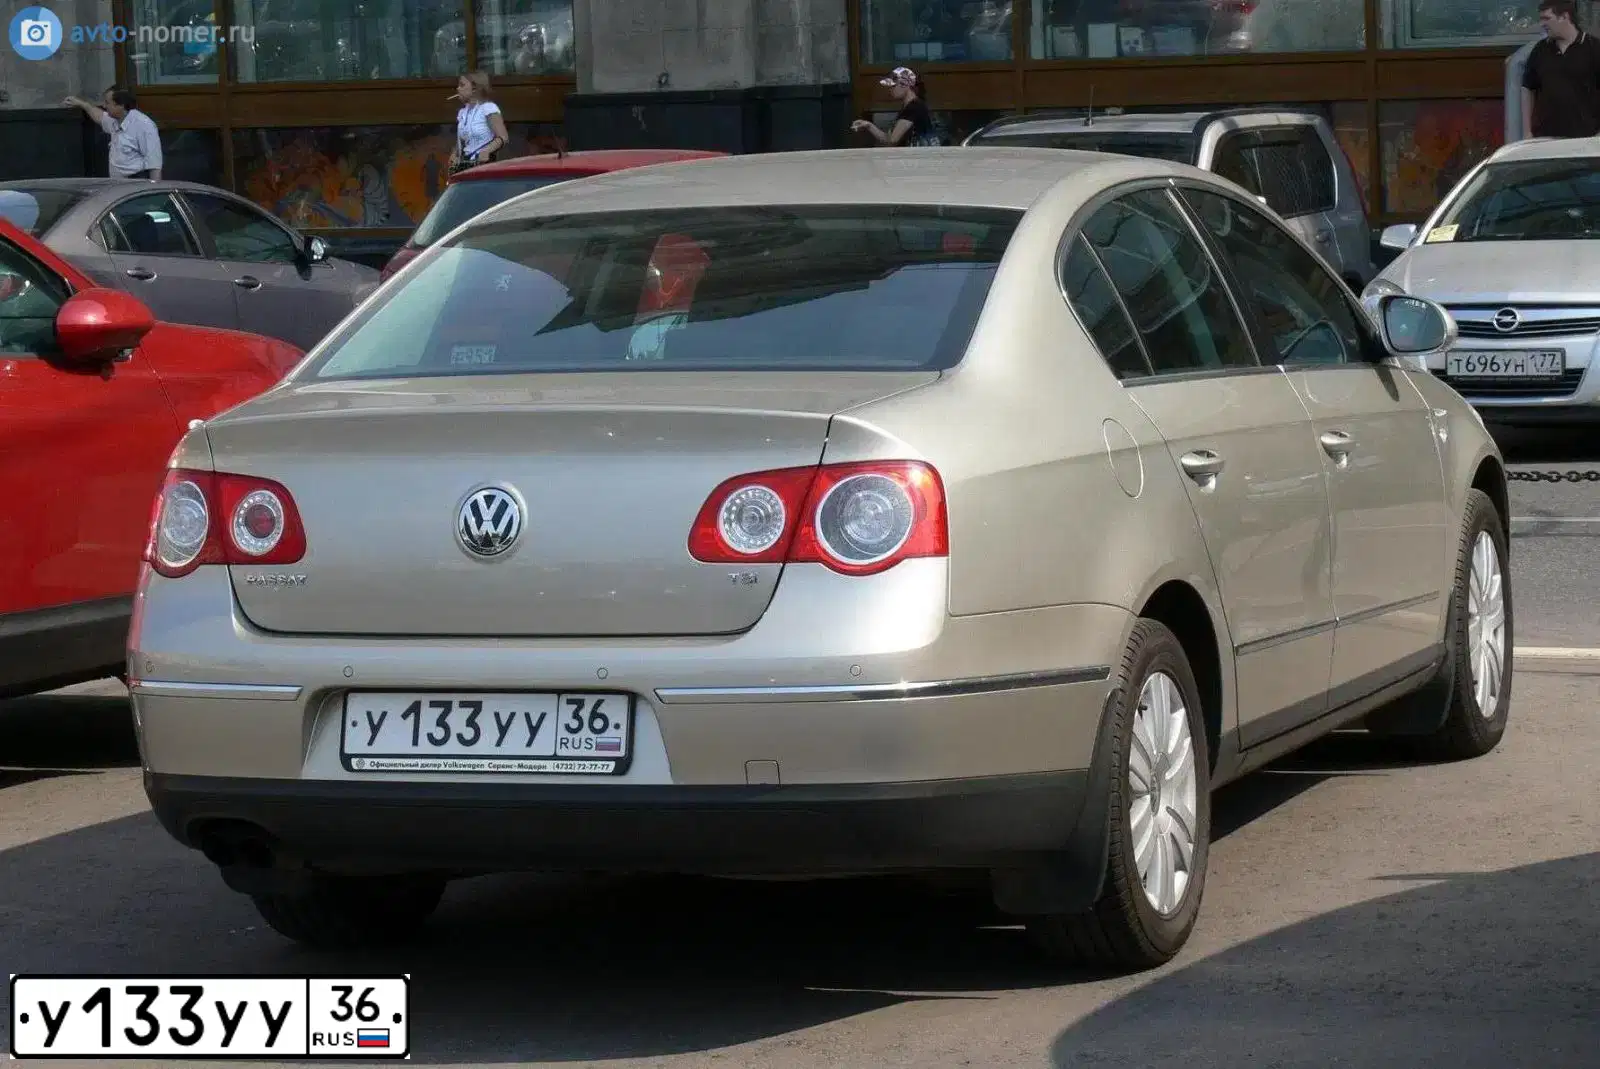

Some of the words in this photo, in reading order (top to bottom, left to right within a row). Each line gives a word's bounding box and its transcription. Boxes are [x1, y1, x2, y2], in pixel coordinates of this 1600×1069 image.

[1454, 354, 1524, 373] Т696УН
[564, 698, 609, 734] 36
[559, 737, 594, 750] RUS
[443, 760, 485, 770] Volkswagen
[552, 762, 575, 771] (4732)
[576, 763, 610, 771] 72-77-77
